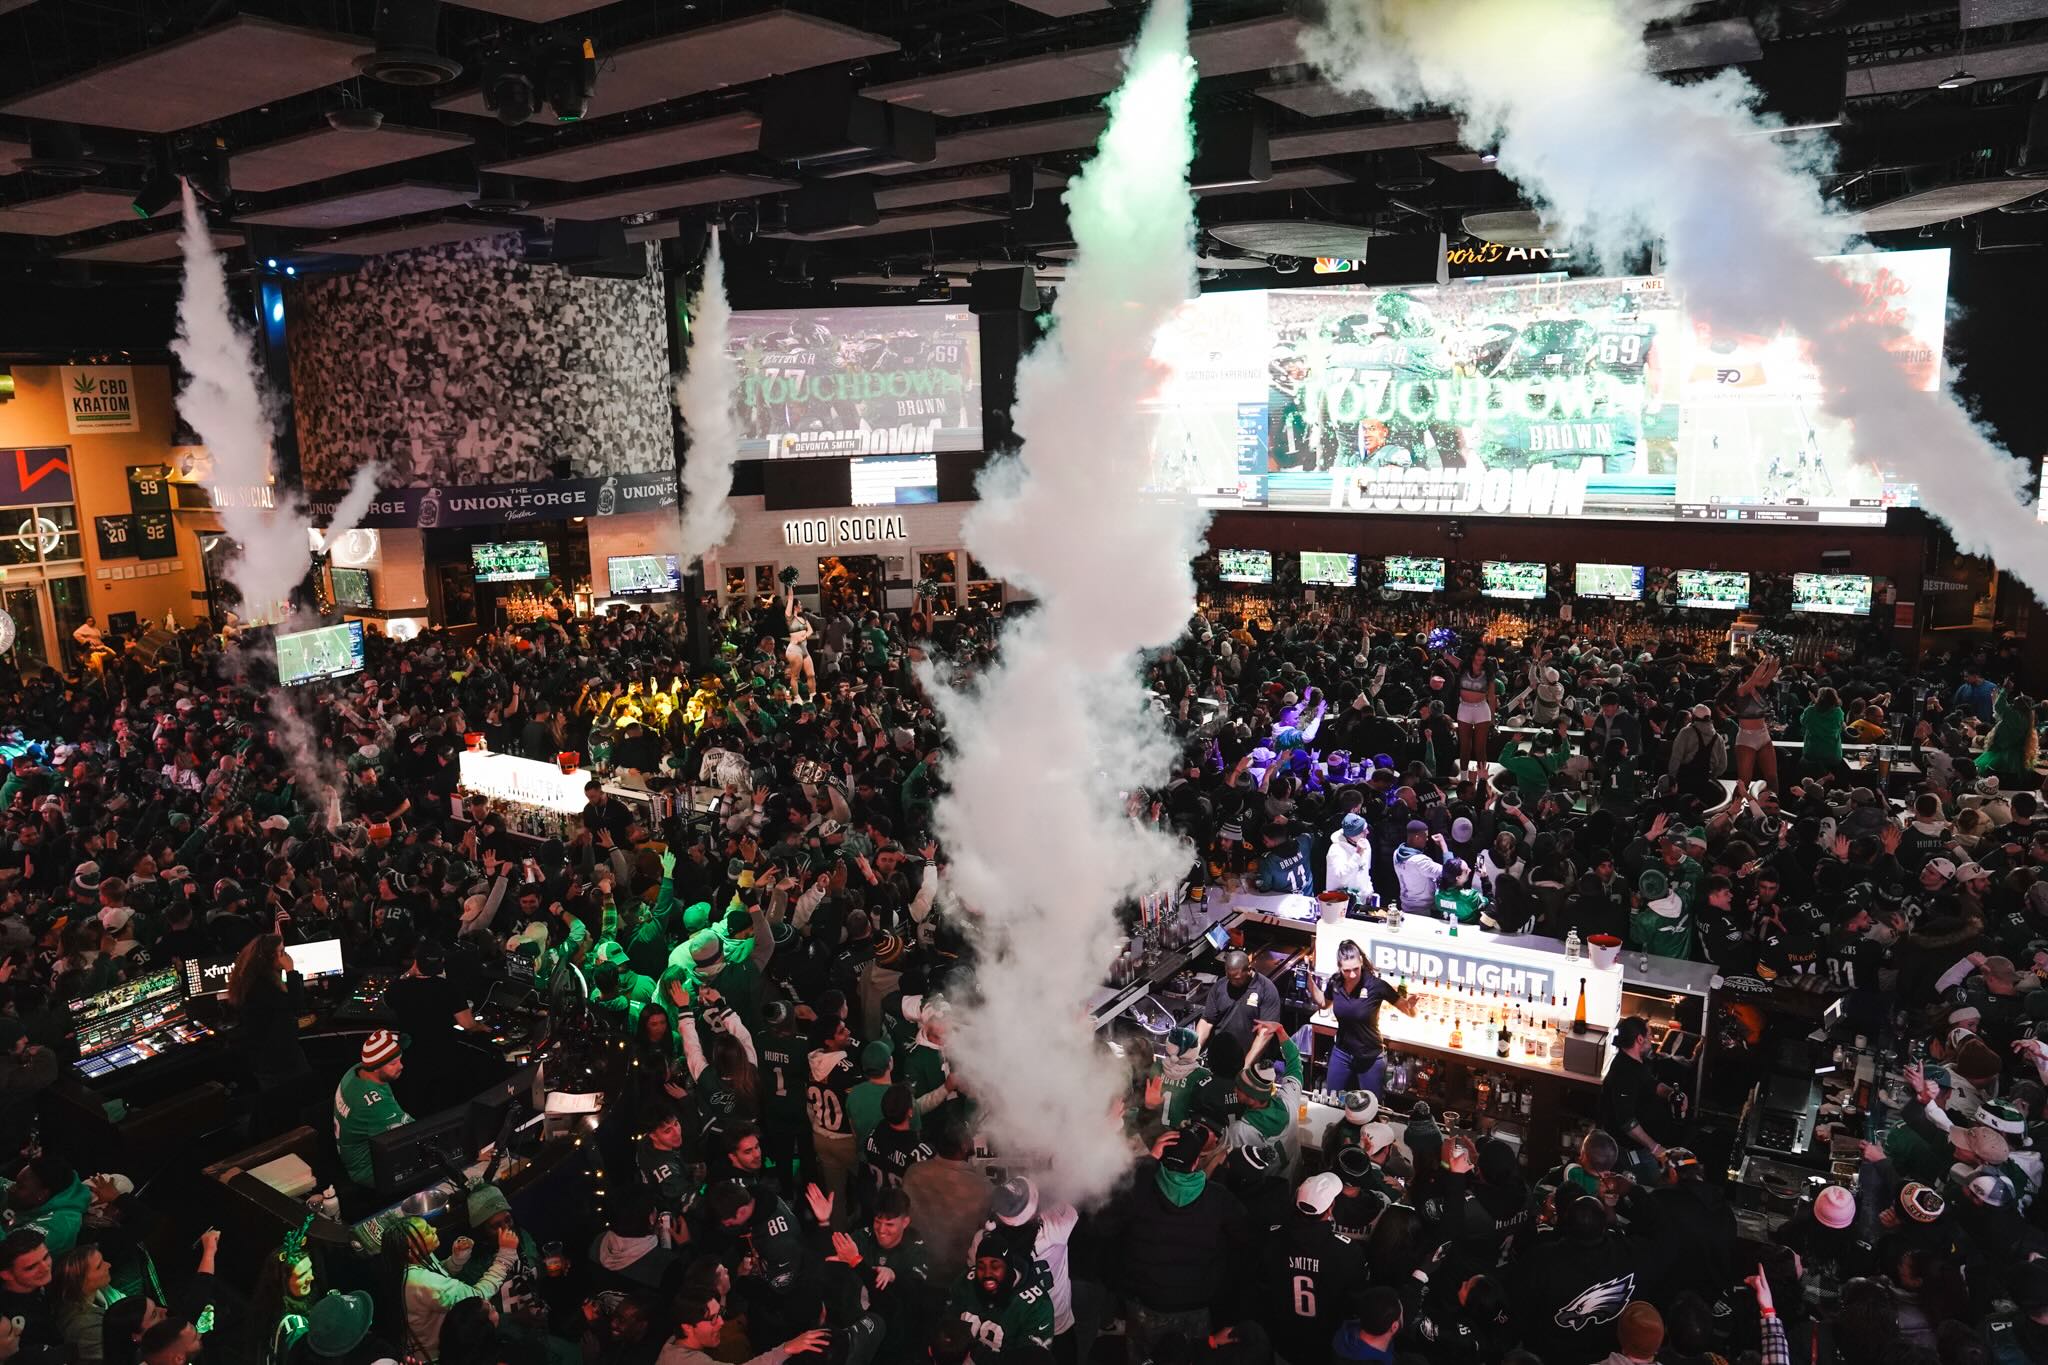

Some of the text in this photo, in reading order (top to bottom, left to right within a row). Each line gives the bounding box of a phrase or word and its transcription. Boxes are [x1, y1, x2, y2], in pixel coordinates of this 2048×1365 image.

[935, 345, 958, 362] 69
[1600, 335, 1641, 364] 69
[100, 379, 127, 395] CBD
[744, 367, 962, 406] TOUCHDOWN
[73, 396, 130, 413] KRATOM
[897, 397, 946, 417] BROWN
[795, 440, 855, 452] DEVONTA SMITH
[1528, 423, 1611, 452] BROWN
[140, 481, 159, 495] 99
[623, 484, 665, 499] UNION
[1369, 483, 1459, 498] DEVONTA SMITH
[309, 502, 336, 515] UNIO
[450, 491, 586, 512] UNION FORGE
[109, 527, 127, 543] 20
[147, 526, 165, 540] 92
[785, 516, 907, 545] 1100 SOCIAL
[480, 556, 543, 567] TOUCHDOWN
[1388, 569, 1441, 578] TOUCHDOWN
[1682, 584, 1745, 595] TOUCHDOWN
[1922, 578, 1969, 592] RESTROOM
[1279, 851, 1304, 870] BROWN
[204, 962, 236, 979] xfinit
[1375, 945, 1548, 997] BUD LIGHT
[764, 1049, 790, 1065] HURTS
[772, 1066, 787, 1097] 1
[363, 1090, 382, 1106] 12
[1161, 1090, 1172, 1126] 1
[652, 1164, 672, 1184] 12
[767, 1216, 788, 1237] 86
[1288, 1255, 1320, 1273] SMITH
[1292, 1275, 1317, 1317] 6
